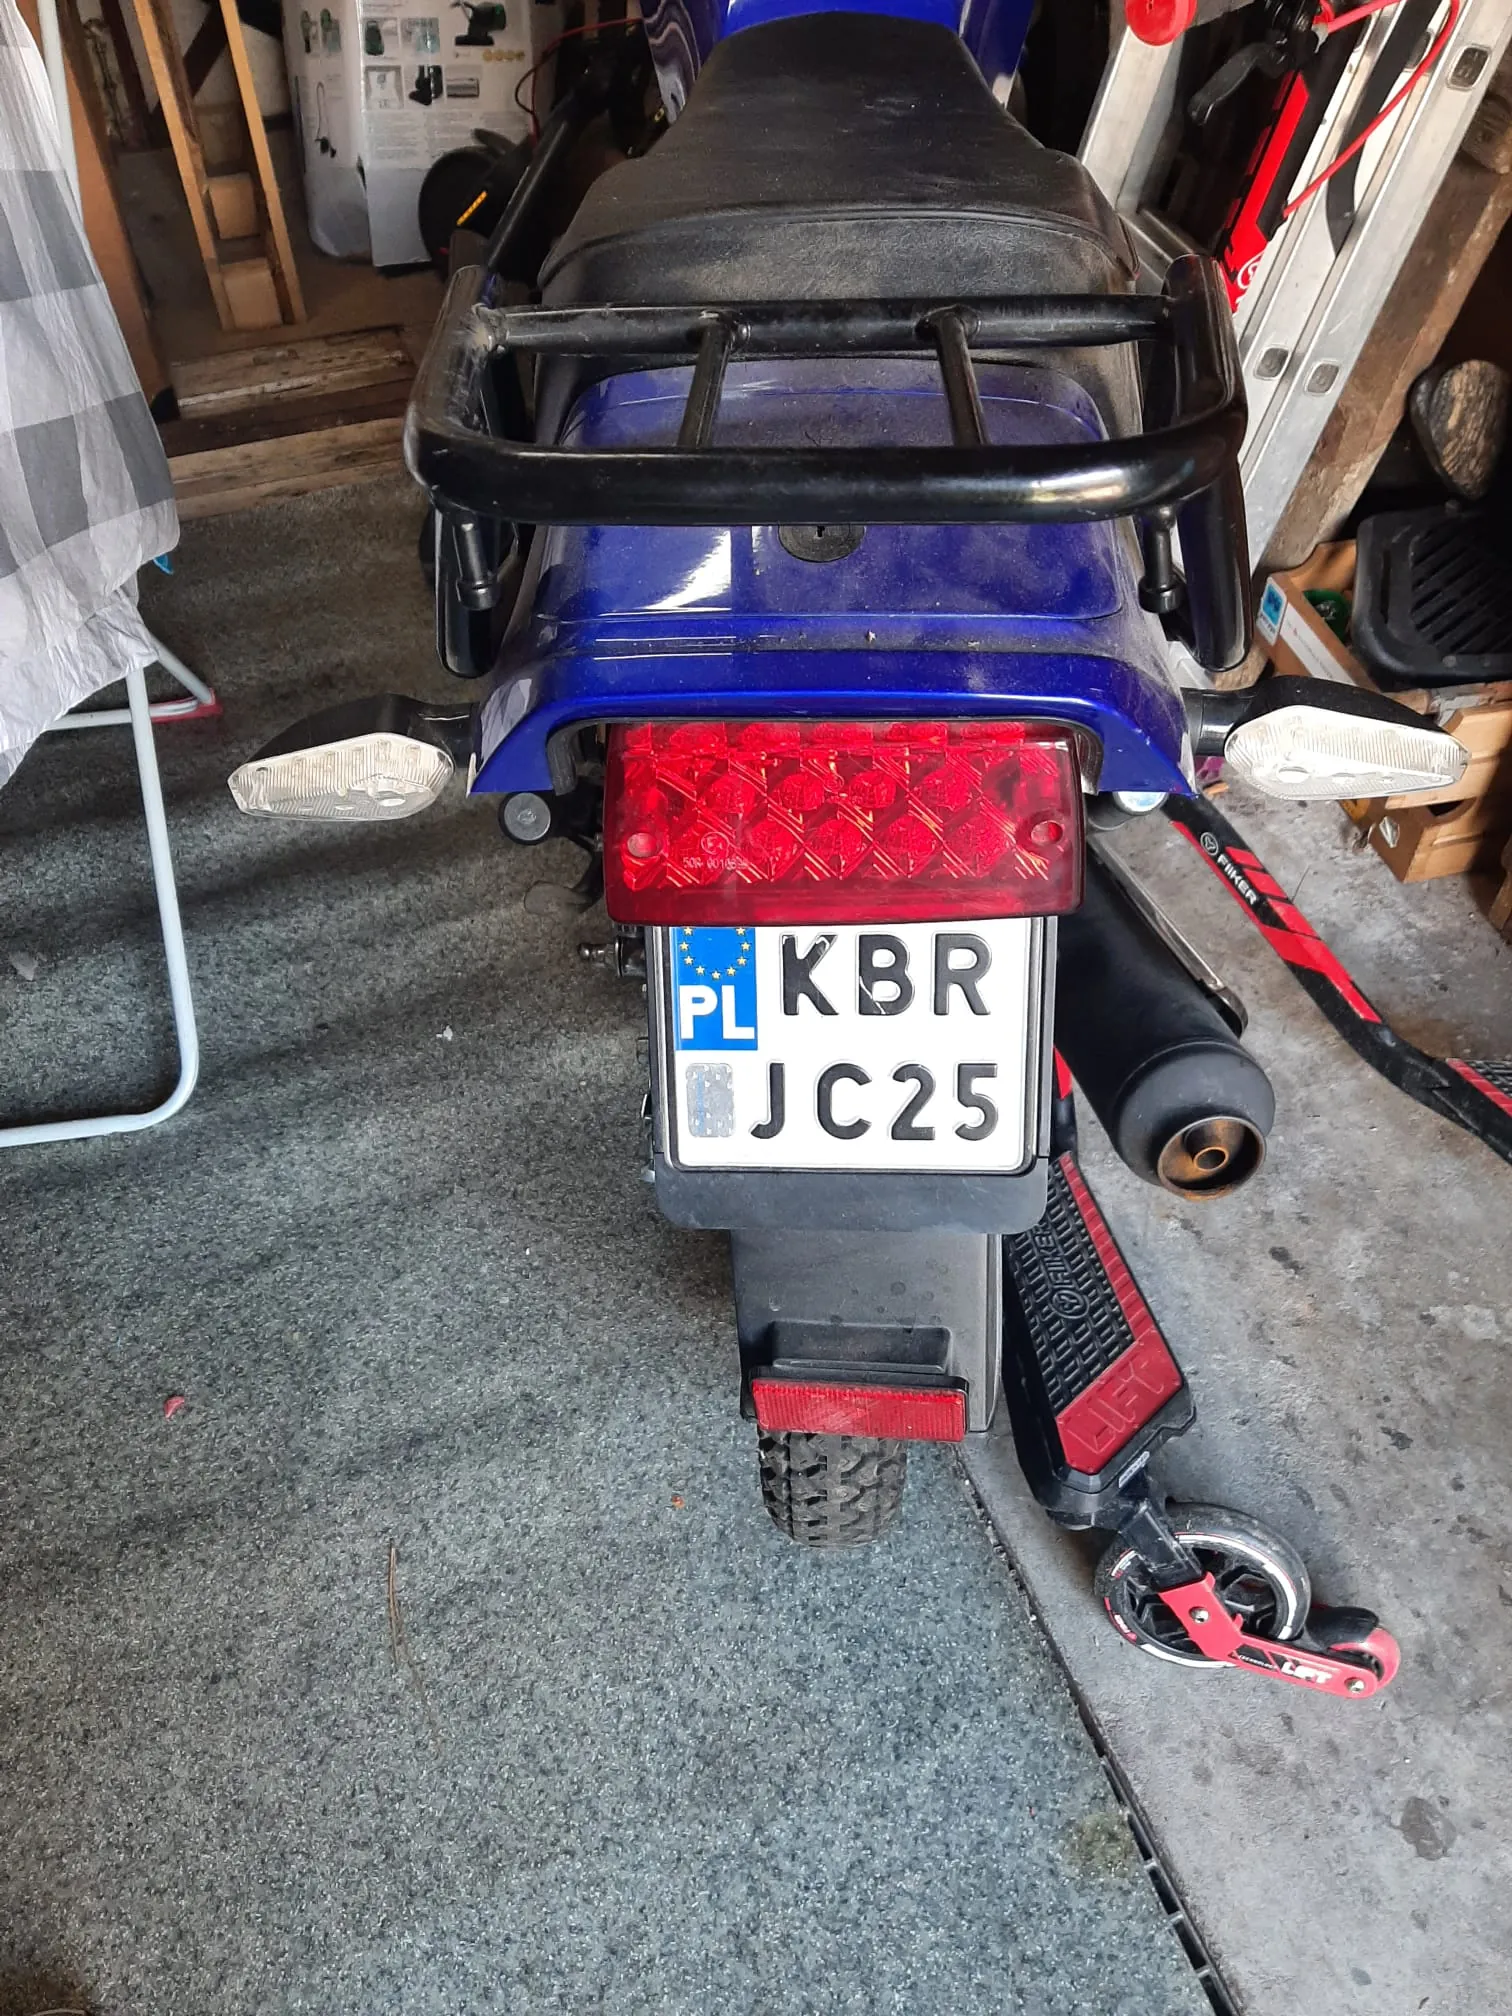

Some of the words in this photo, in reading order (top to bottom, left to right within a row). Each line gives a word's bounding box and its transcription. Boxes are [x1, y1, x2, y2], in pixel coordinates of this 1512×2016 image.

[1217, 853, 1257, 905] FIIKER
[781, 933, 991, 1016] KBR
[680, 985, 754, 1040] PL
[750, 1062, 999, 1141] JC25
